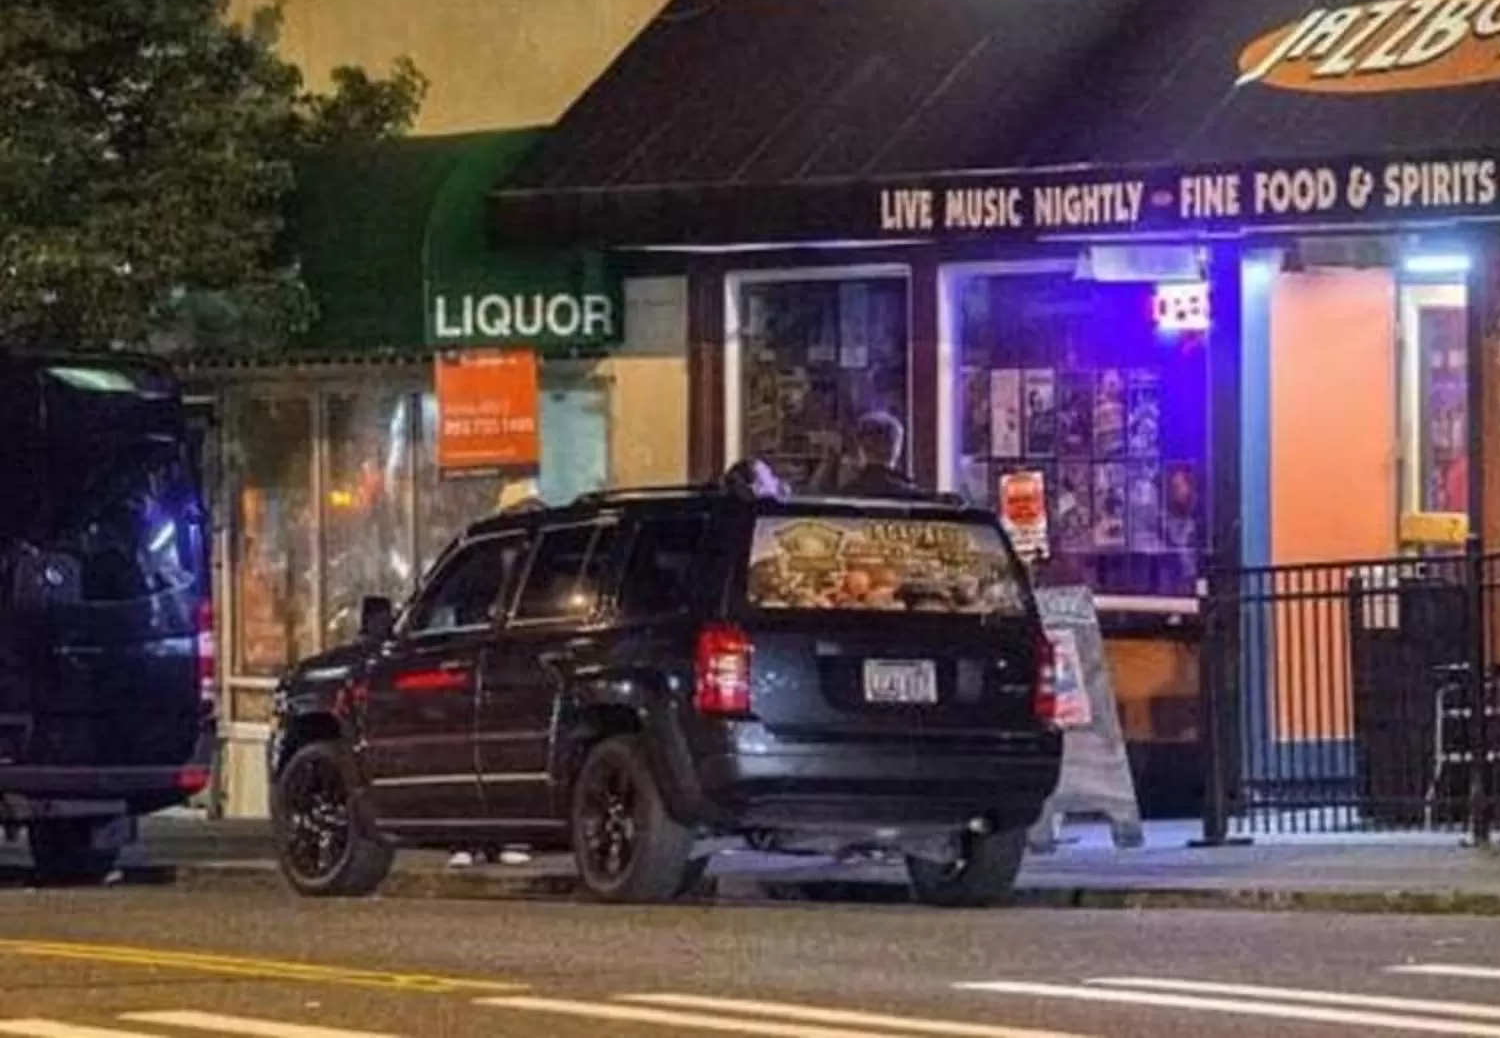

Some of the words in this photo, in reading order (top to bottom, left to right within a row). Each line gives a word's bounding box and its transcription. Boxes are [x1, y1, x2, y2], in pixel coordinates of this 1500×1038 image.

[880, 189, 934, 230] LIVE
[945, 187, 1023, 229] MUSIC
[1033, 180, 1144, 226] NIGHTLY
[1180, 174, 1241, 219] FINE
[1254, 167, 1338, 214] FOOD
[1346, 165, 1374, 210] &
[1383, 159, 1497, 208] SPIRITS
[435, 293, 613, 338] LIQUOR
